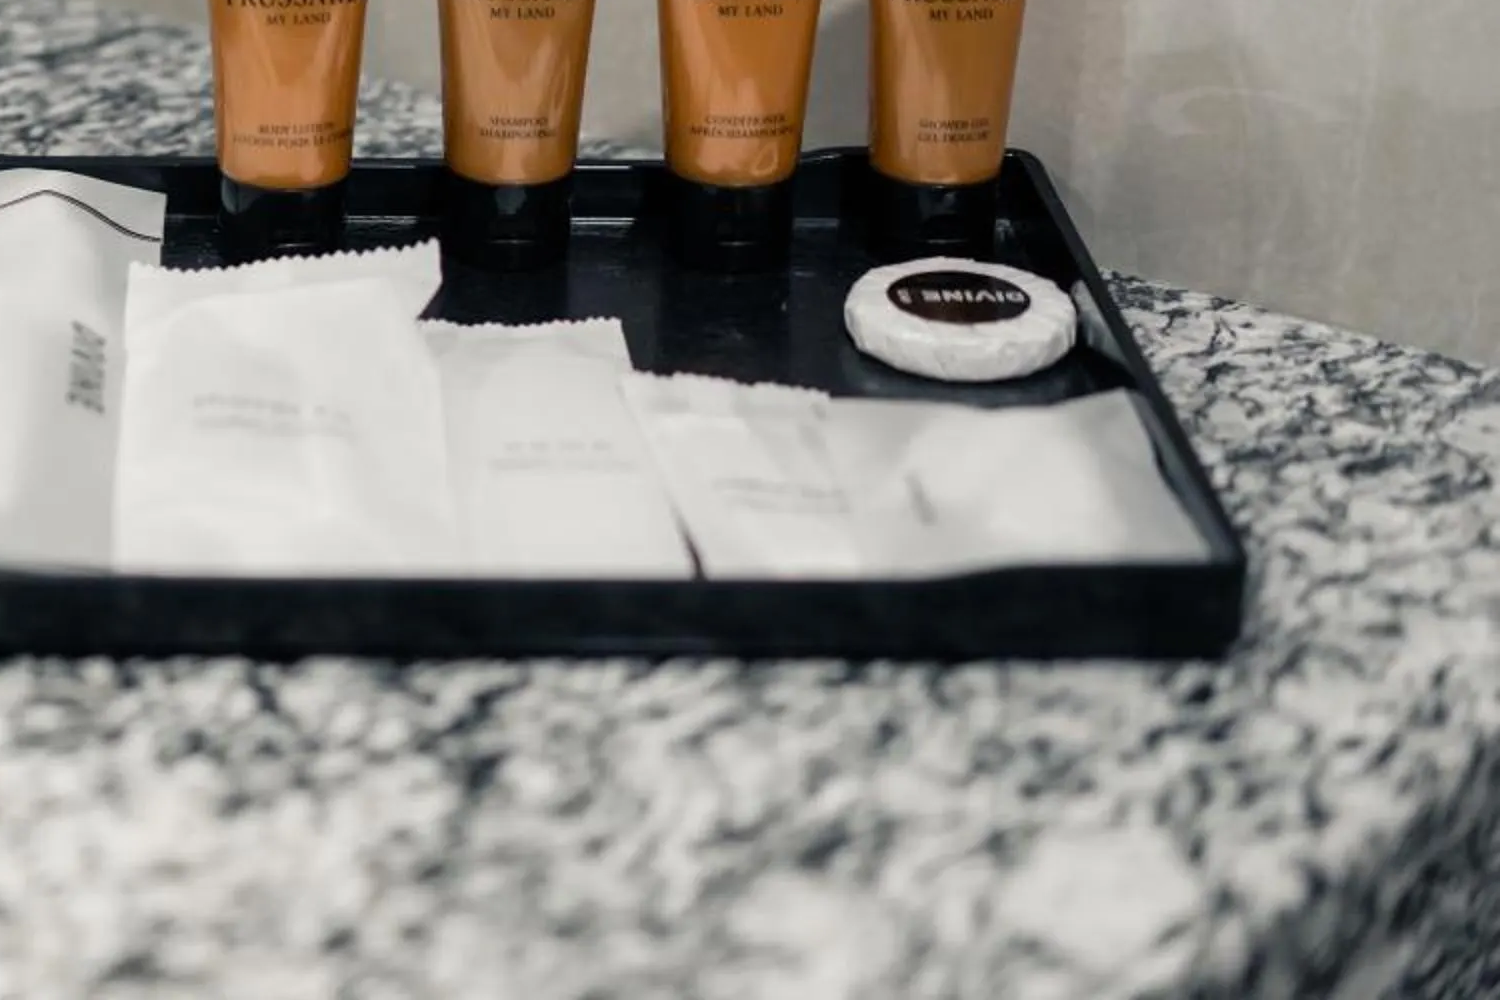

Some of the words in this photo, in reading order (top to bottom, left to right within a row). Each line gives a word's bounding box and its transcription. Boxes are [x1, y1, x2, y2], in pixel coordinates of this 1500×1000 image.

[490, 7, 510, 20] MY
[517, 7, 556, 21] LAND
[719, 5, 738, 18] MY
[745, 3, 784, 18] LAND
[930, 8, 948, 21] MY
[955, 8, 994, 21] LAND
[266, 13, 286, 26] MY
[294, 11, 332, 25] LAND
[919, 288, 1025, 304] DIVINE
